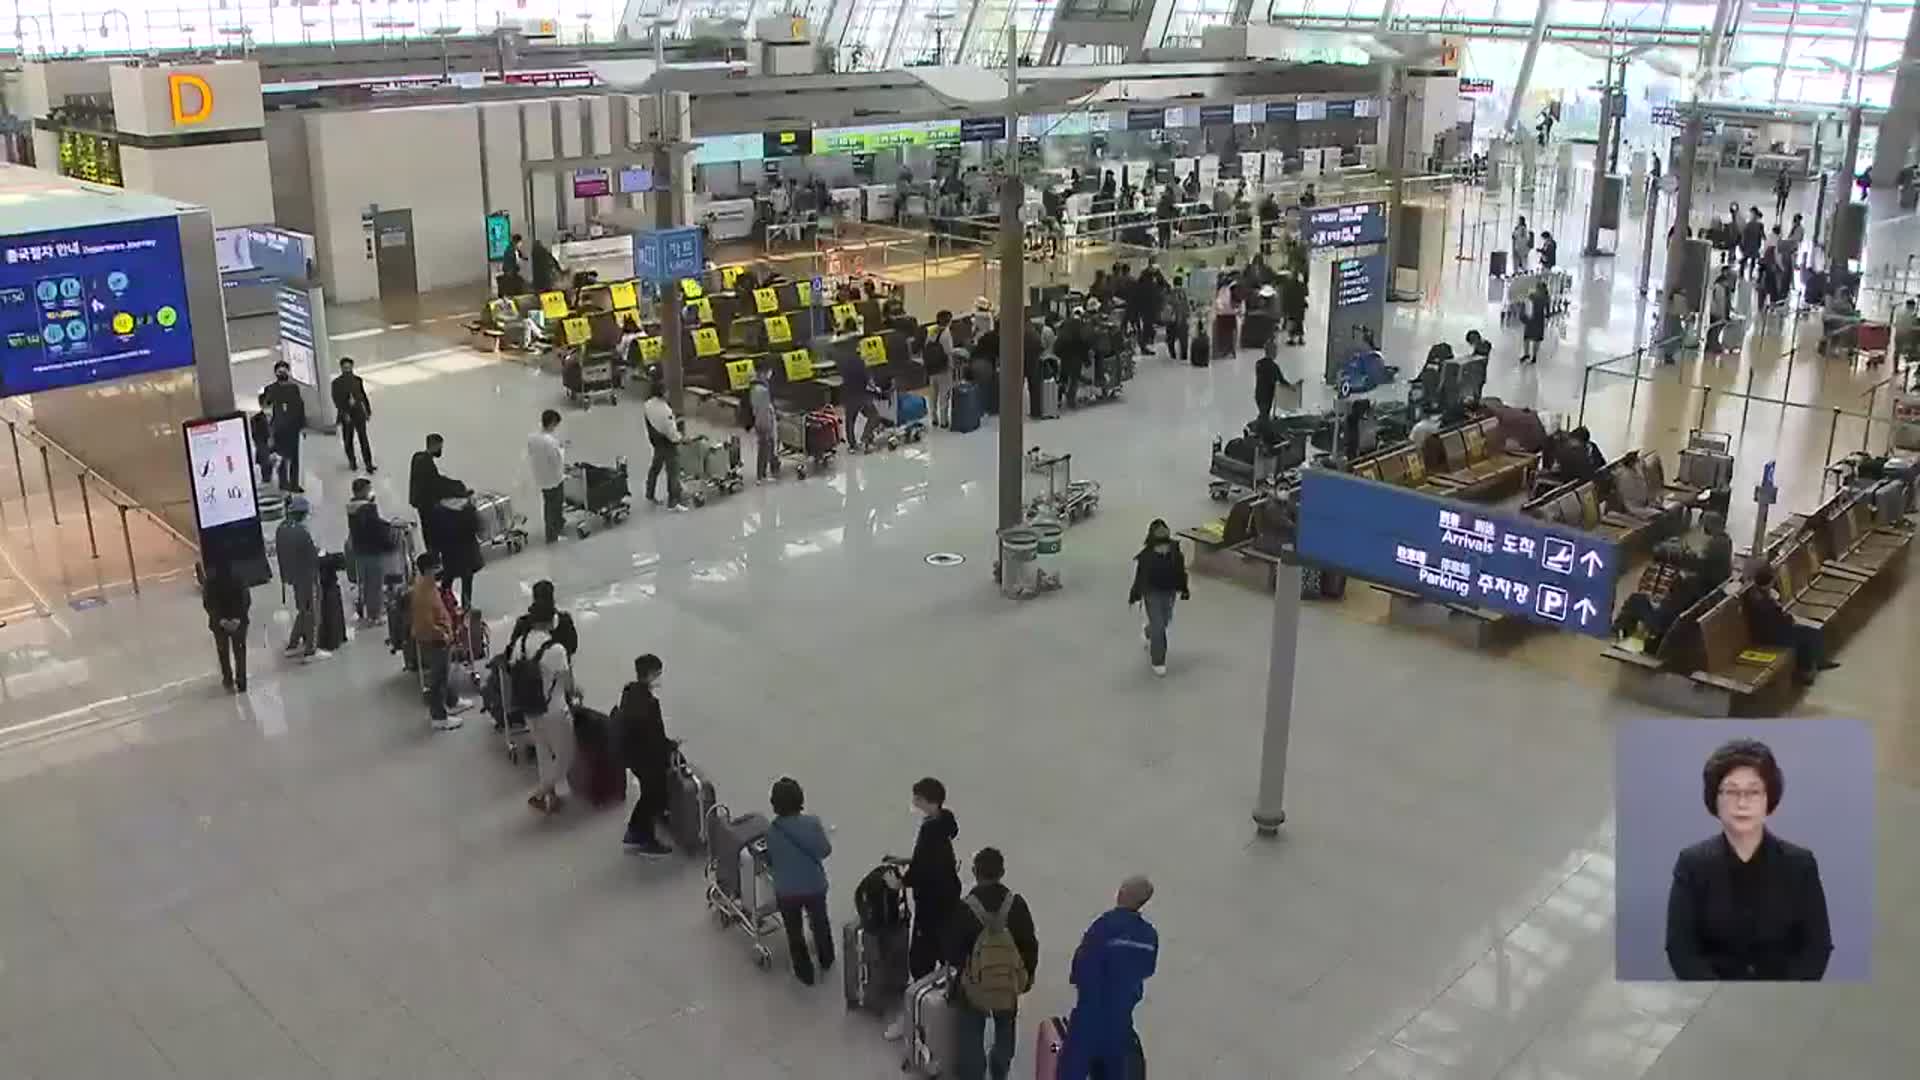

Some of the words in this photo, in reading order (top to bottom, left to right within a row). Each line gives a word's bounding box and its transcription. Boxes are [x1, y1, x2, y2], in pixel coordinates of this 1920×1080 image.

[168, 73, 213, 127] D
[1441, 530, 1494, 554] Arrivals
[1502, 533, 1536, 559] 도착
[1419, 568, 1470, 597] Parking
[1477, 573, 1530, 605] 주차장
[1544, 591, 1562, 613] P
